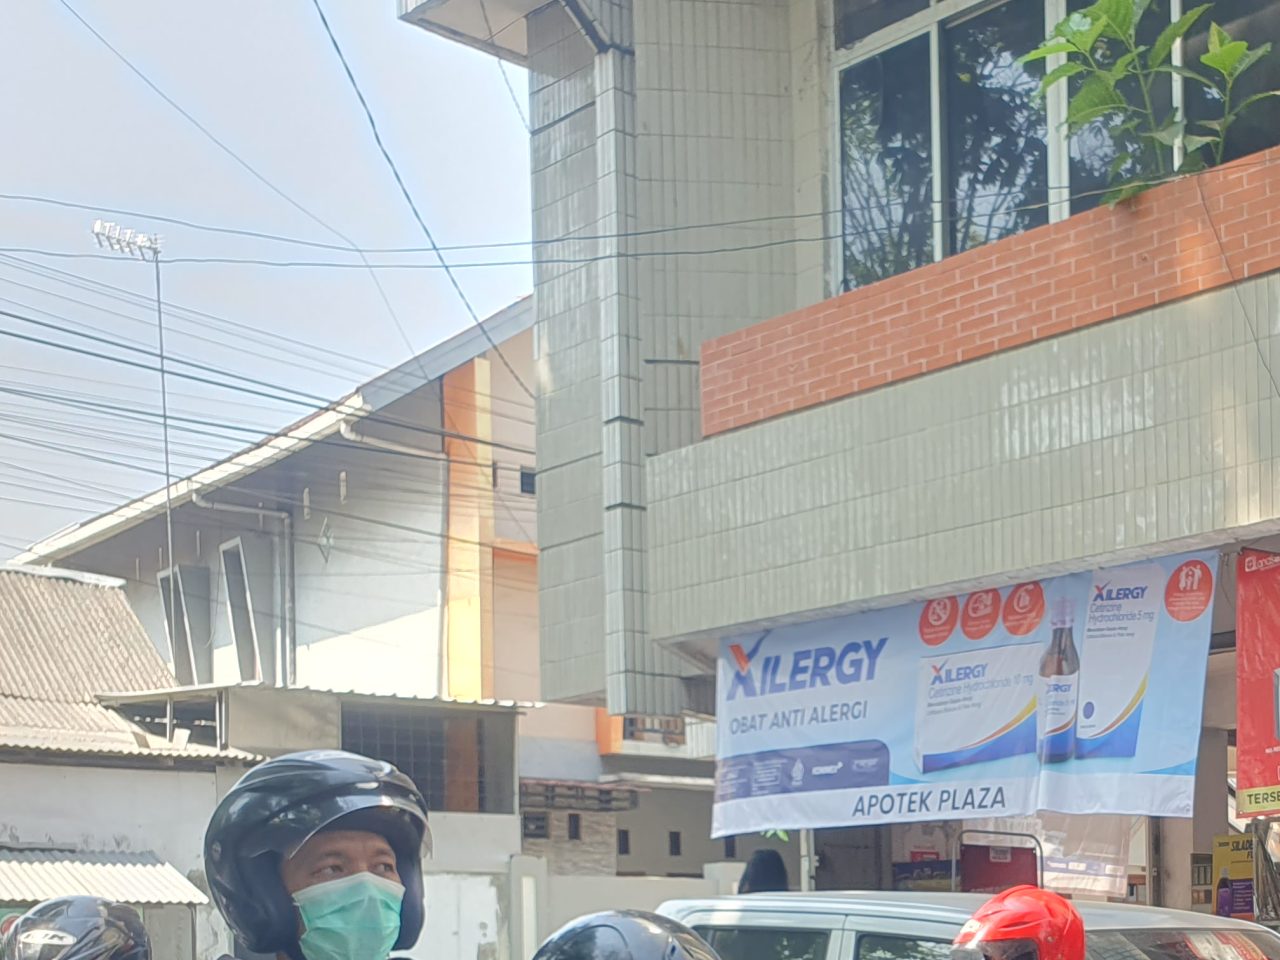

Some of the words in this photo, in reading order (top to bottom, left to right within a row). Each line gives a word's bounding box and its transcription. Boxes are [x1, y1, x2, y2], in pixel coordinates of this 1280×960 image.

[1092, 580, 1148, 602] XILERGY
[726, 629, 889, 701] XILERGY
[930, 658, 988, 686] XILERGY
[730, 713, 768, 735] OBAT
[769, 708, 806, 730] ANTI
[808, 700, 868, 725] ALERGI
[852, 790, 932, 817] APOTEK
[938, 786, 1006, 812] PLAZA
